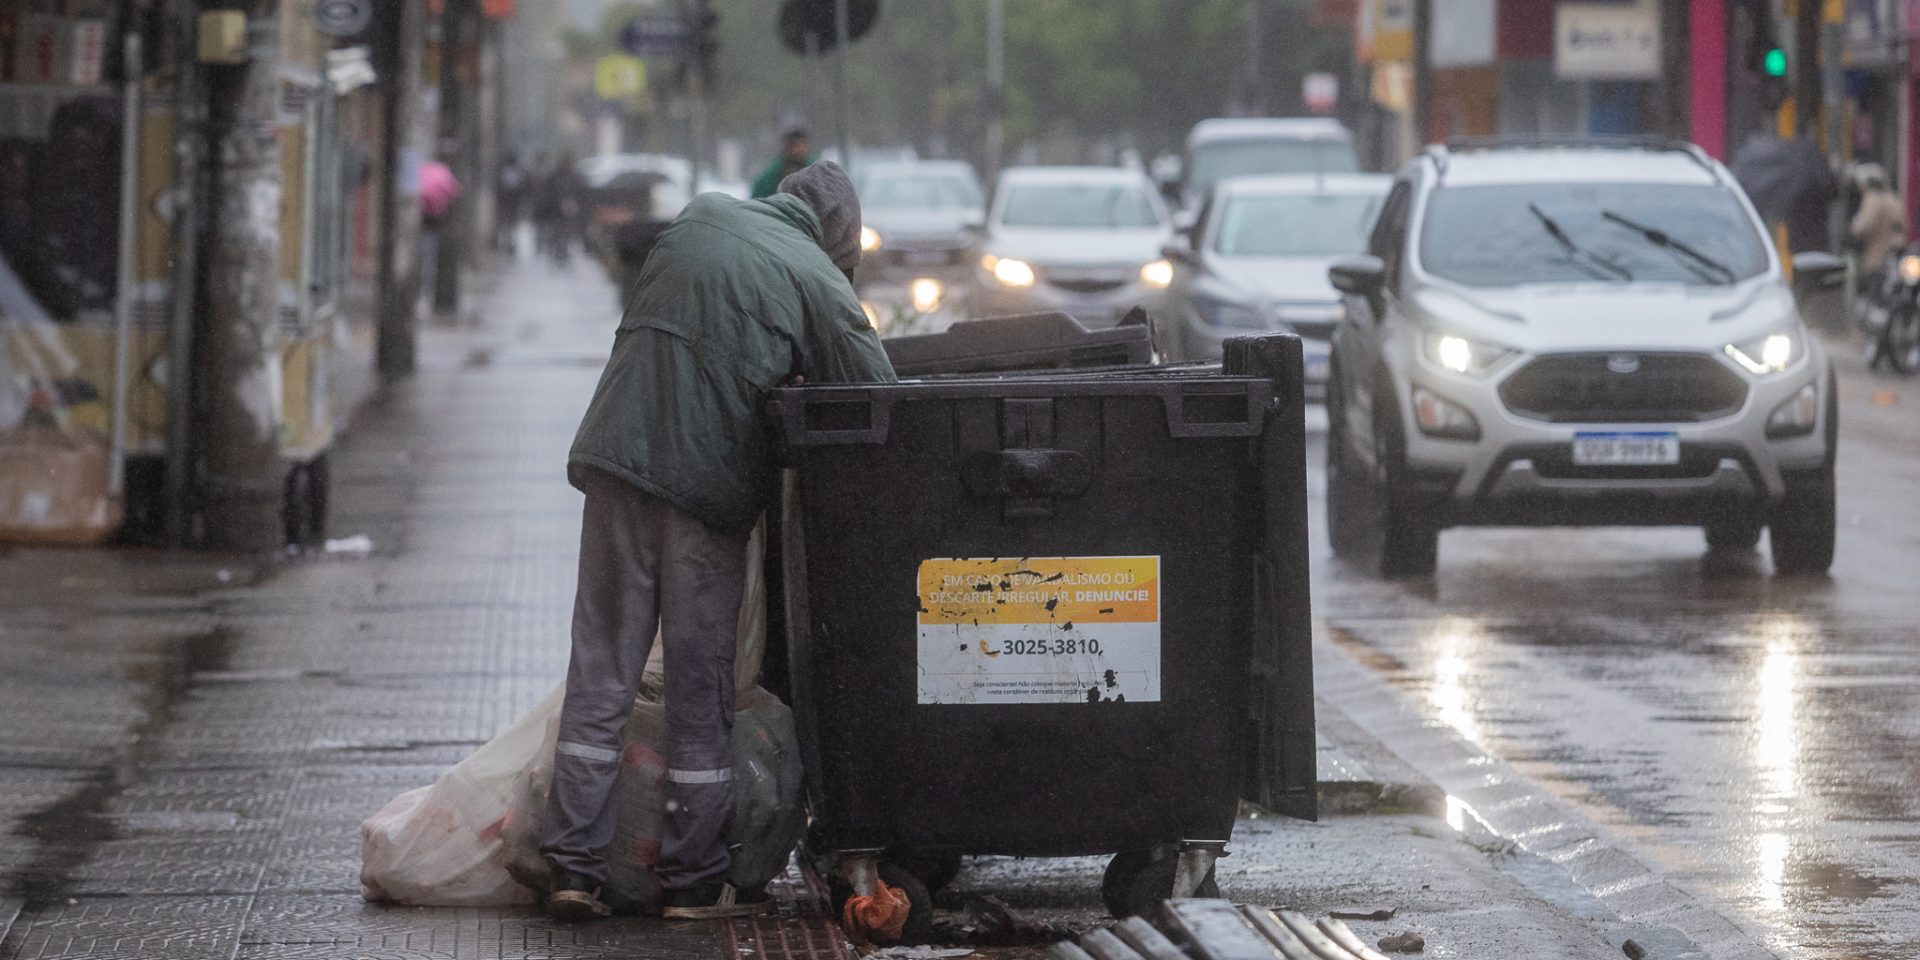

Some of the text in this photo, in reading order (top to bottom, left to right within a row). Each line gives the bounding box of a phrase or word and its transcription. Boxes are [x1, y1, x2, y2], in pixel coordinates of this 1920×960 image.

[943, 574, 963, 586] EM
[1023, 572, 1111, 586] VANDALISMO
[1113, 571, 1135, 585] OU
[930, 591, 994, 605] DESCARTE
[1075, 589, 1149, 602] DENUNCIE!
[1031, 687, 1038, 695] de
